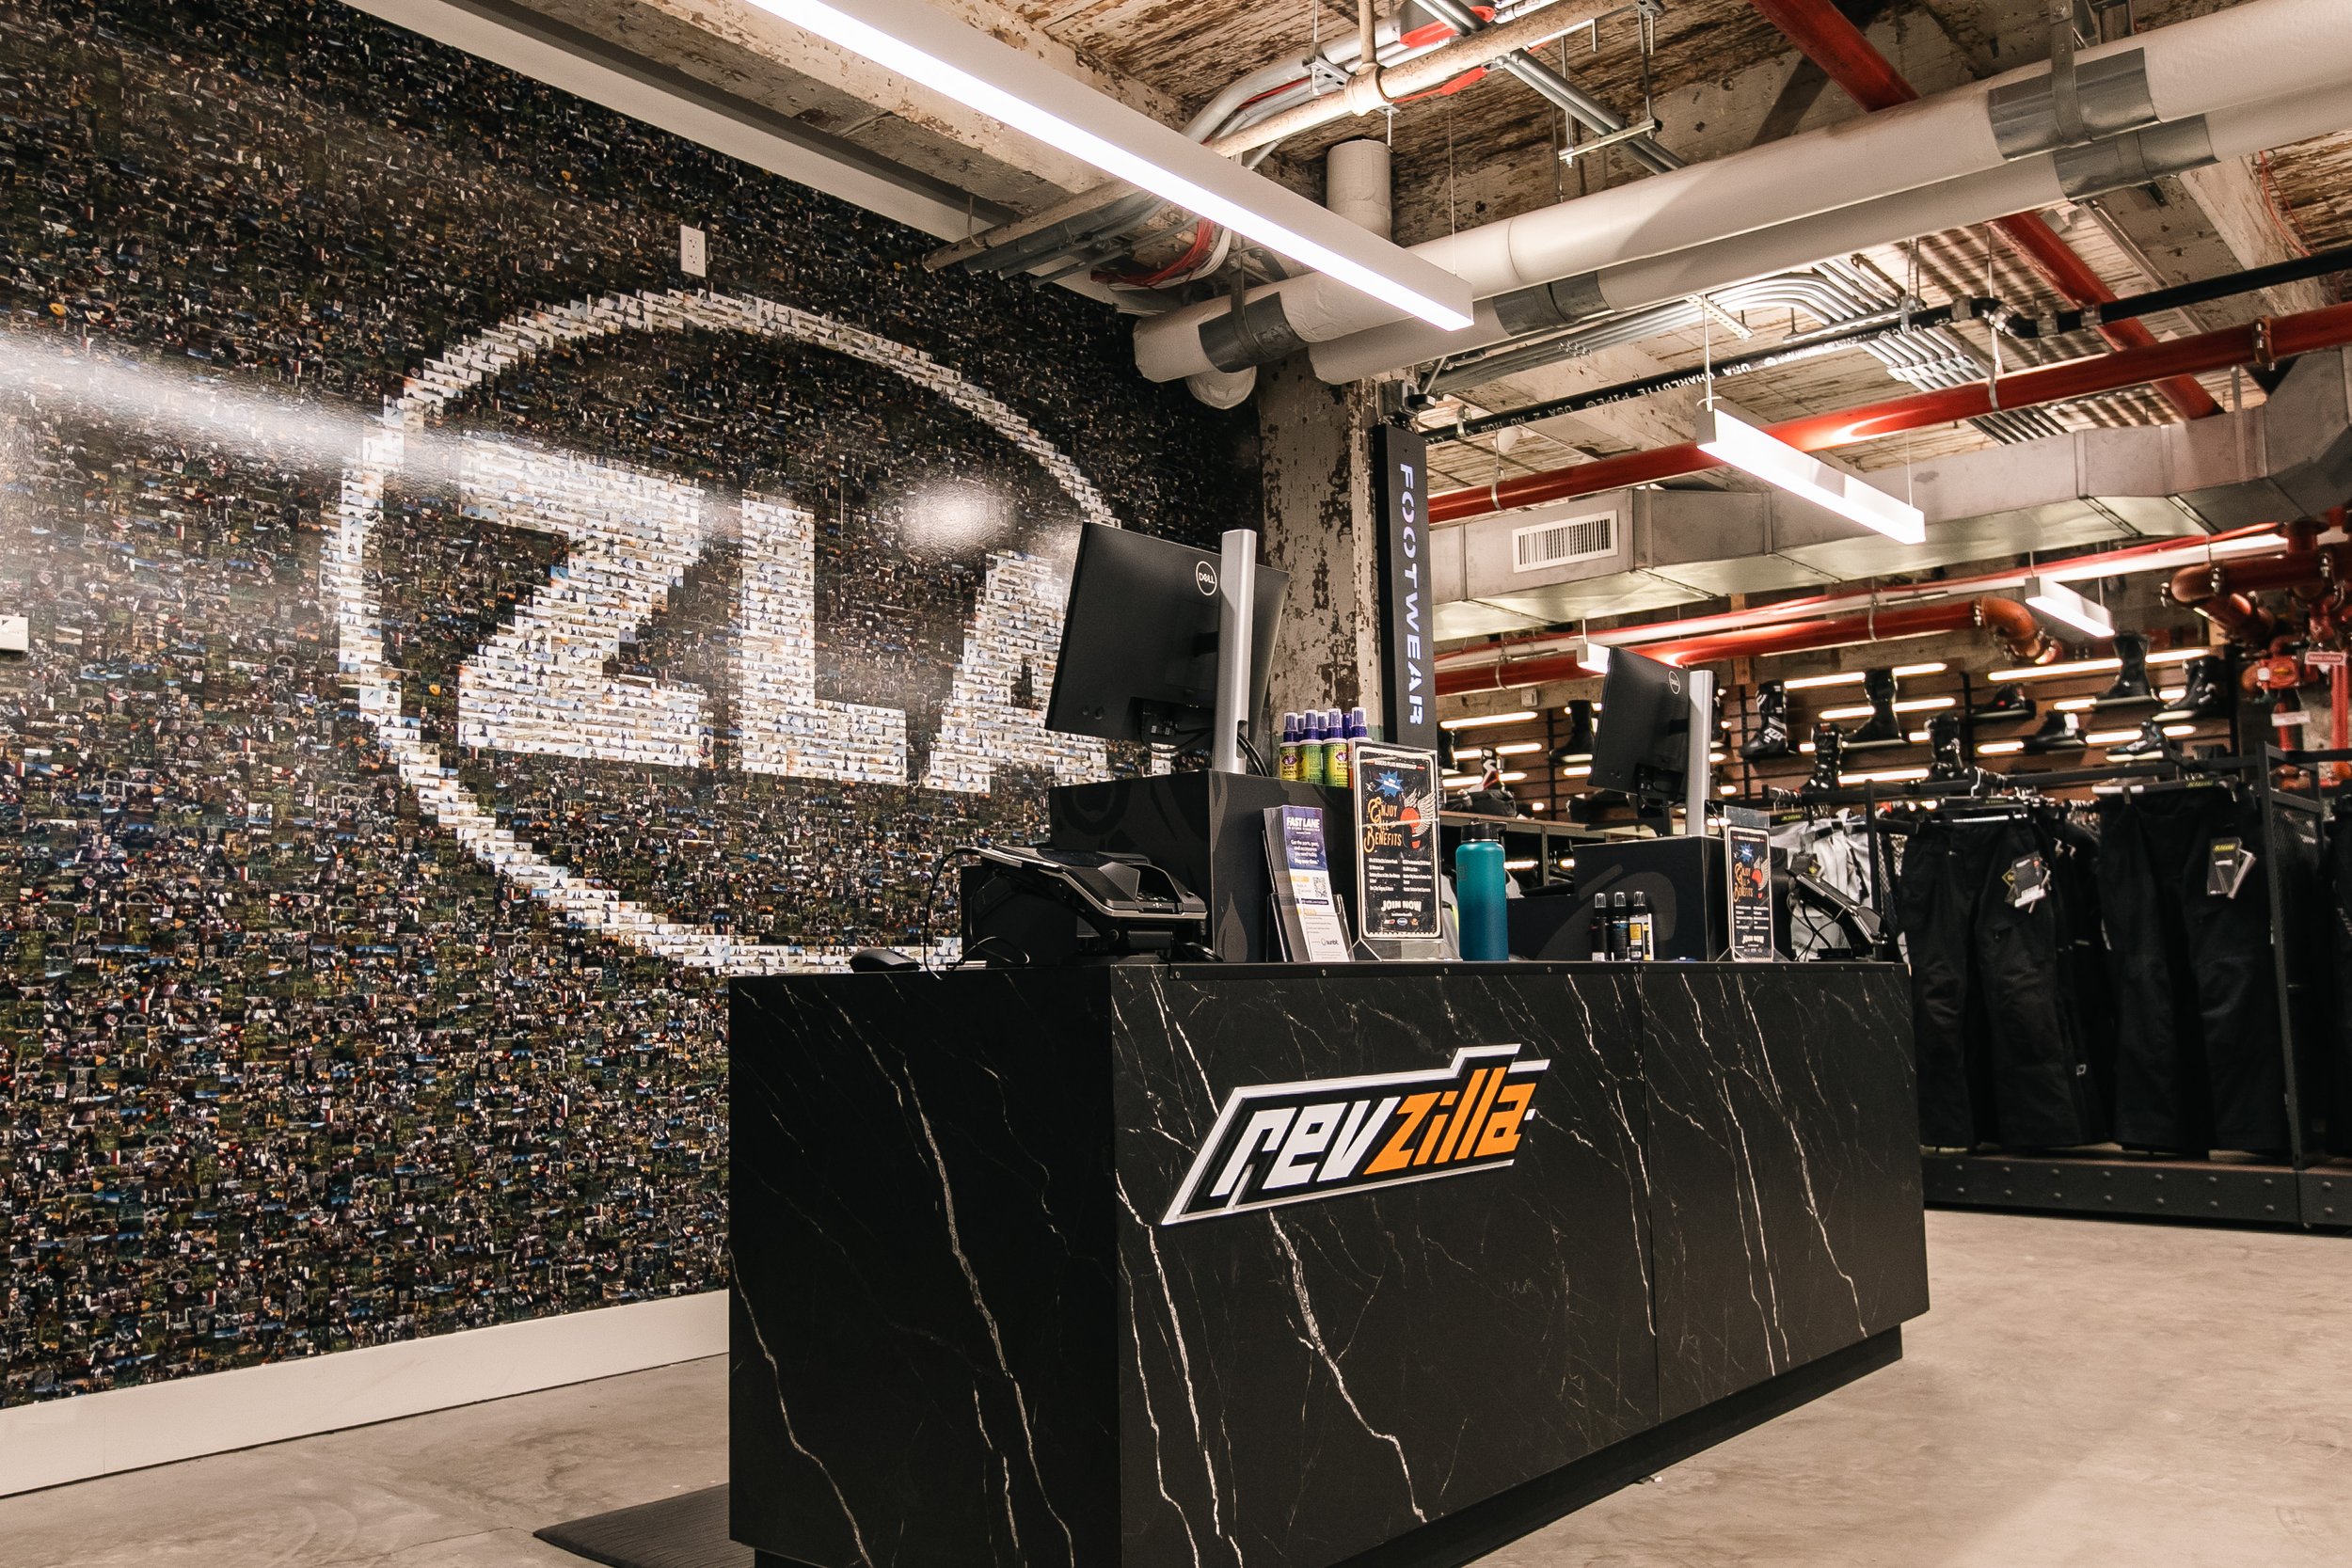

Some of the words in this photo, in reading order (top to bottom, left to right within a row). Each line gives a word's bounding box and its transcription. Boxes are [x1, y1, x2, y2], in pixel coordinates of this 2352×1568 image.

[1548, 404, 1573, 417] USA
[1199, 572, 1216, 584] DELL
[1400, 463, 1424, 725] FOOTWEAR
[1368, 796, 1398, 825] ENJOY
[1286, 816, 1303, 827] FAST
[1303, 818, 1320, 828] LANE
[1363, 826, 1402, 853] BENEFITS
[1381, 900, 1401, 911] JOIN
[1402, 900, 1422, 912] NOW
[1210, 1067, 1536, 1197] revzilla
